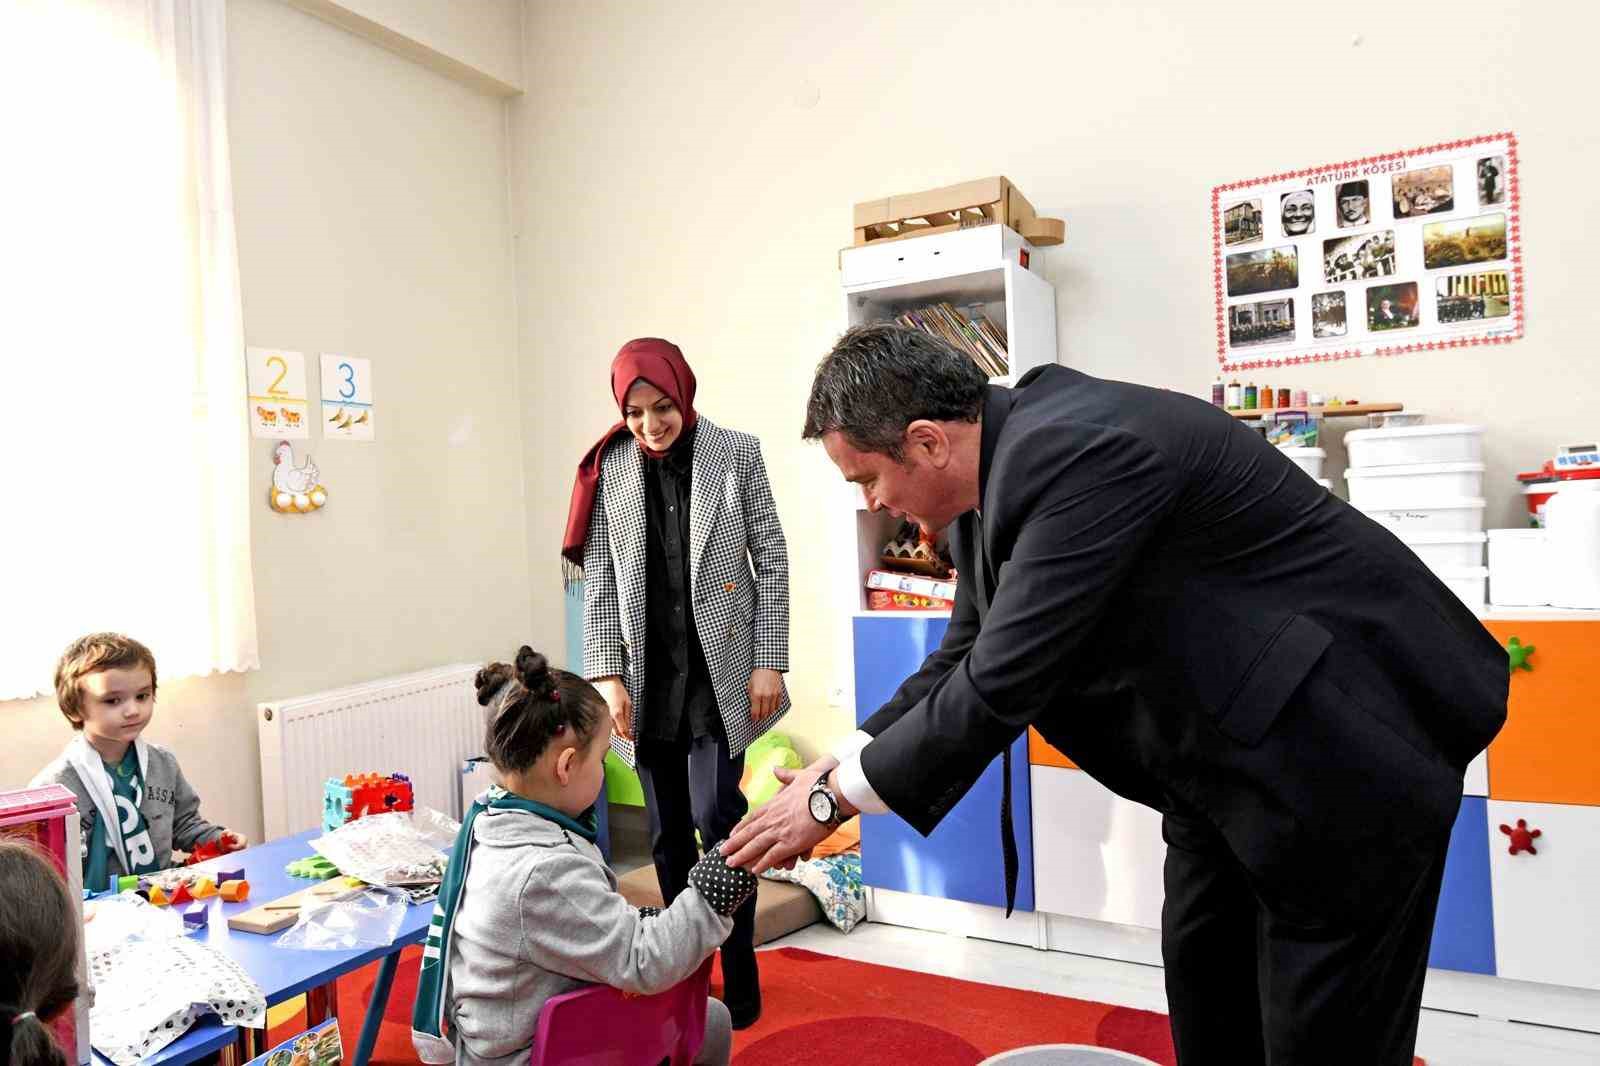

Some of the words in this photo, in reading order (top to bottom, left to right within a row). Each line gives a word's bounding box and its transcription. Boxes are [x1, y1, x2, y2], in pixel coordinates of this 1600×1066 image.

[1306, 169, 1359, 186] ATATÜRK
[1363, 159, 1406, 176] KÖŞESİ
[265, 356, 289, 394] 2
[338, 363, 355, 398] 3
